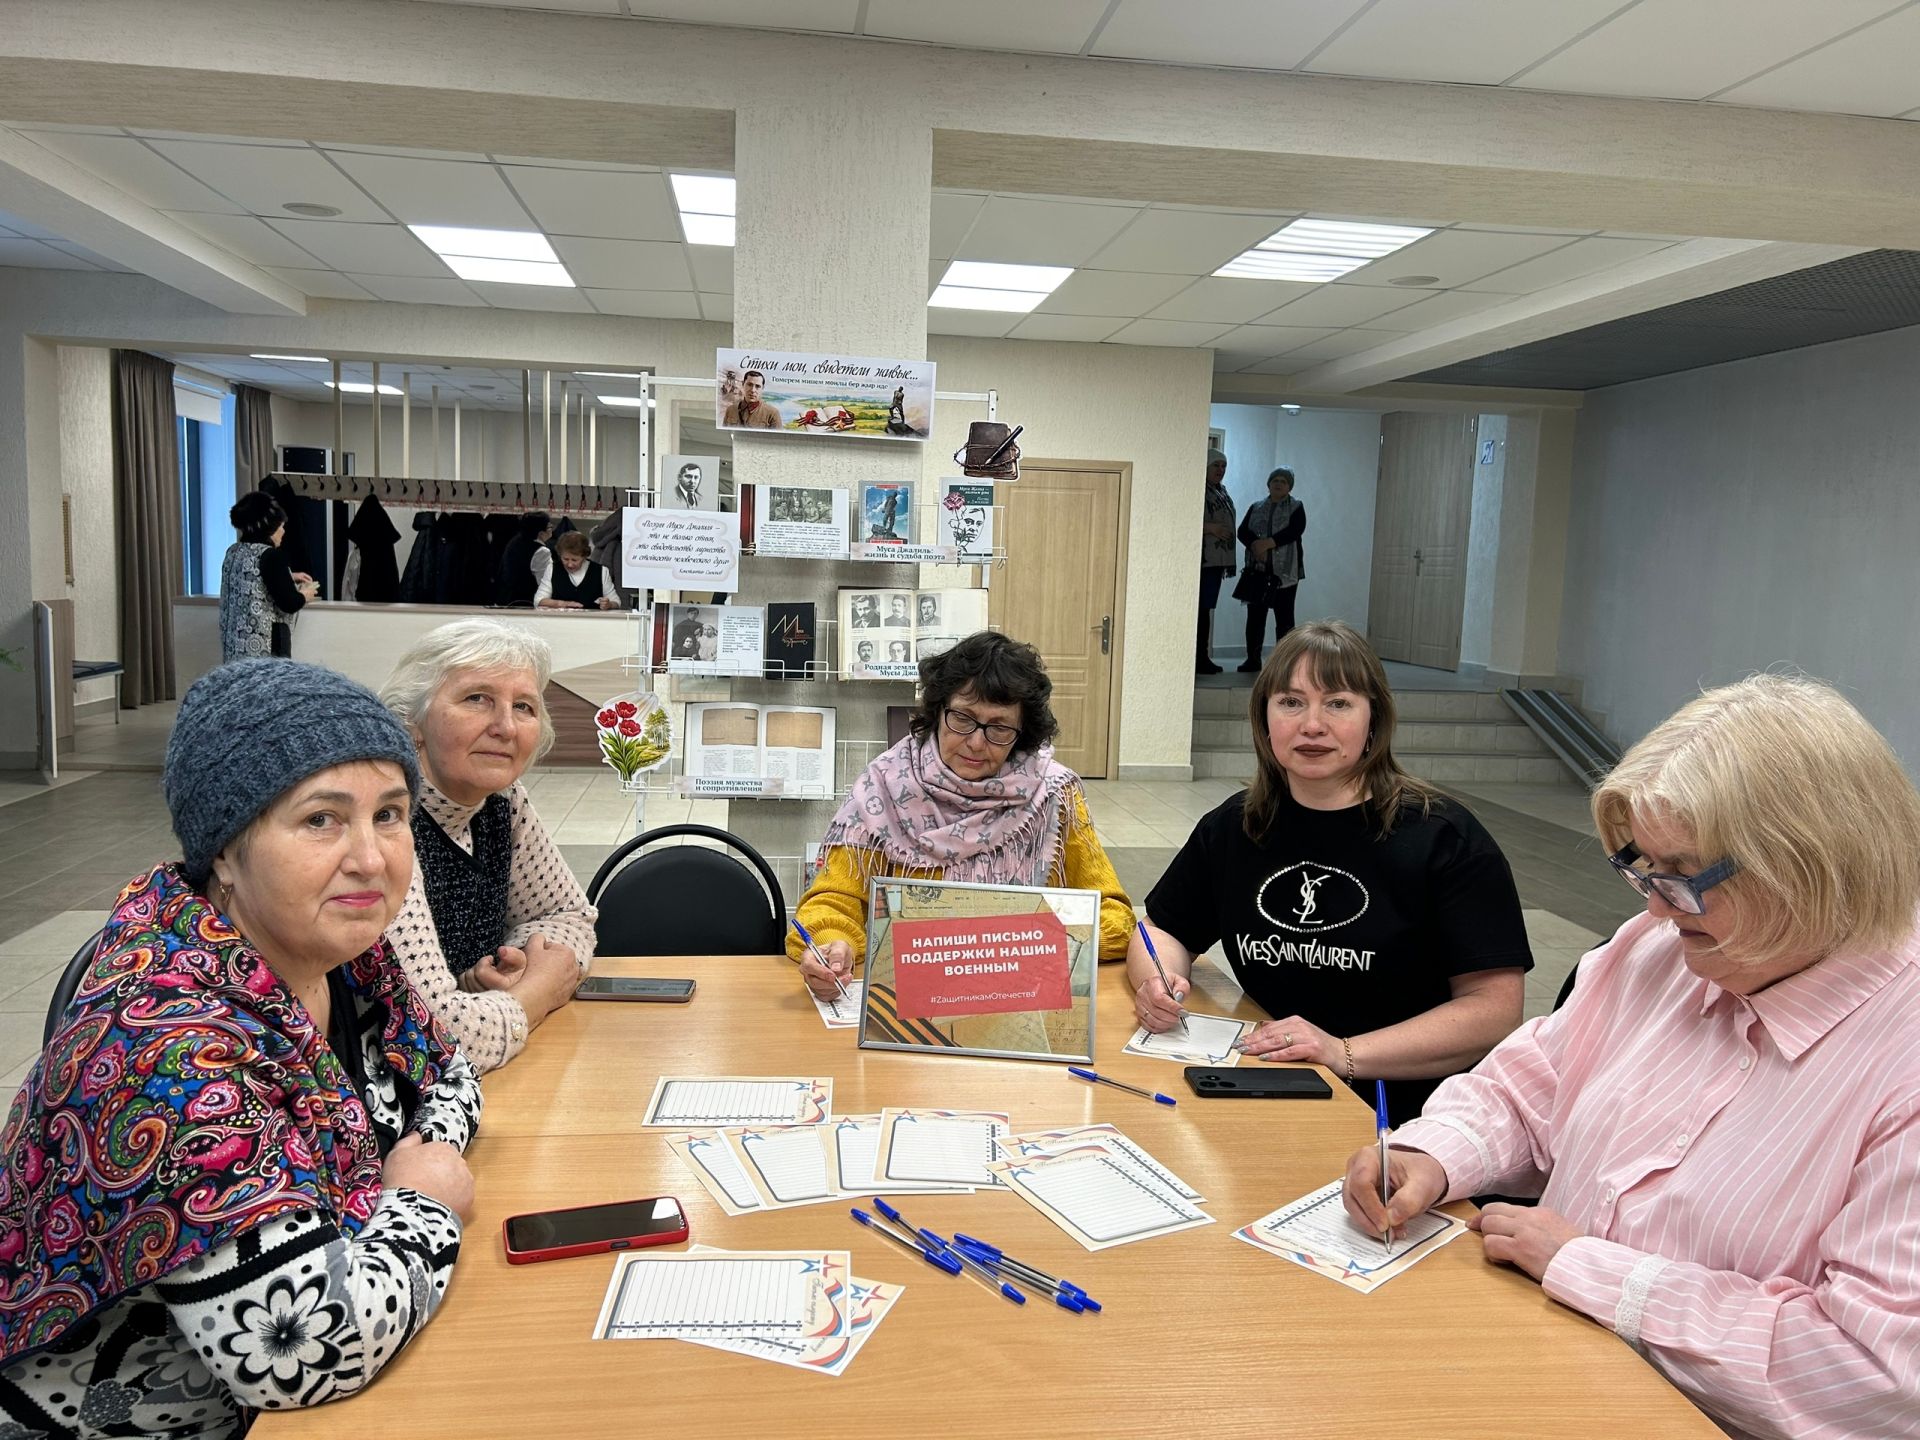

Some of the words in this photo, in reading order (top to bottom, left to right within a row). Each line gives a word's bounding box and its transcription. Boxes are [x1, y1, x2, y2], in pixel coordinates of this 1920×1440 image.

[739, 355, 779, 371] Стихи
[781, 361, 808, 375] мои,
[813, 359, 871, 377] свидетели
[874, 364, 919, 380] живые...
[876, 545, 896, 554] Муса
[896, 552, 922, 560] судьба
[864, 663, 892, 671] Родная
[695, 778, 724, 786] Поэзия
[725, 780, 763, 788] мужества
[702, 785, 763, 793] сопротивления
[912, 933, 977, 948] НАПИШИ
[981, 929, 1044, 943] ПИСЬМО
[901, 947, 996, 965] ПОДДЕРЖКИ
[1000, 944, 1057, 959] НАШИМ
[944, 961, 1019, 976] ВОЕННЫМ
[930, 989, 1036, 1004] #ZащитникамОтечества
